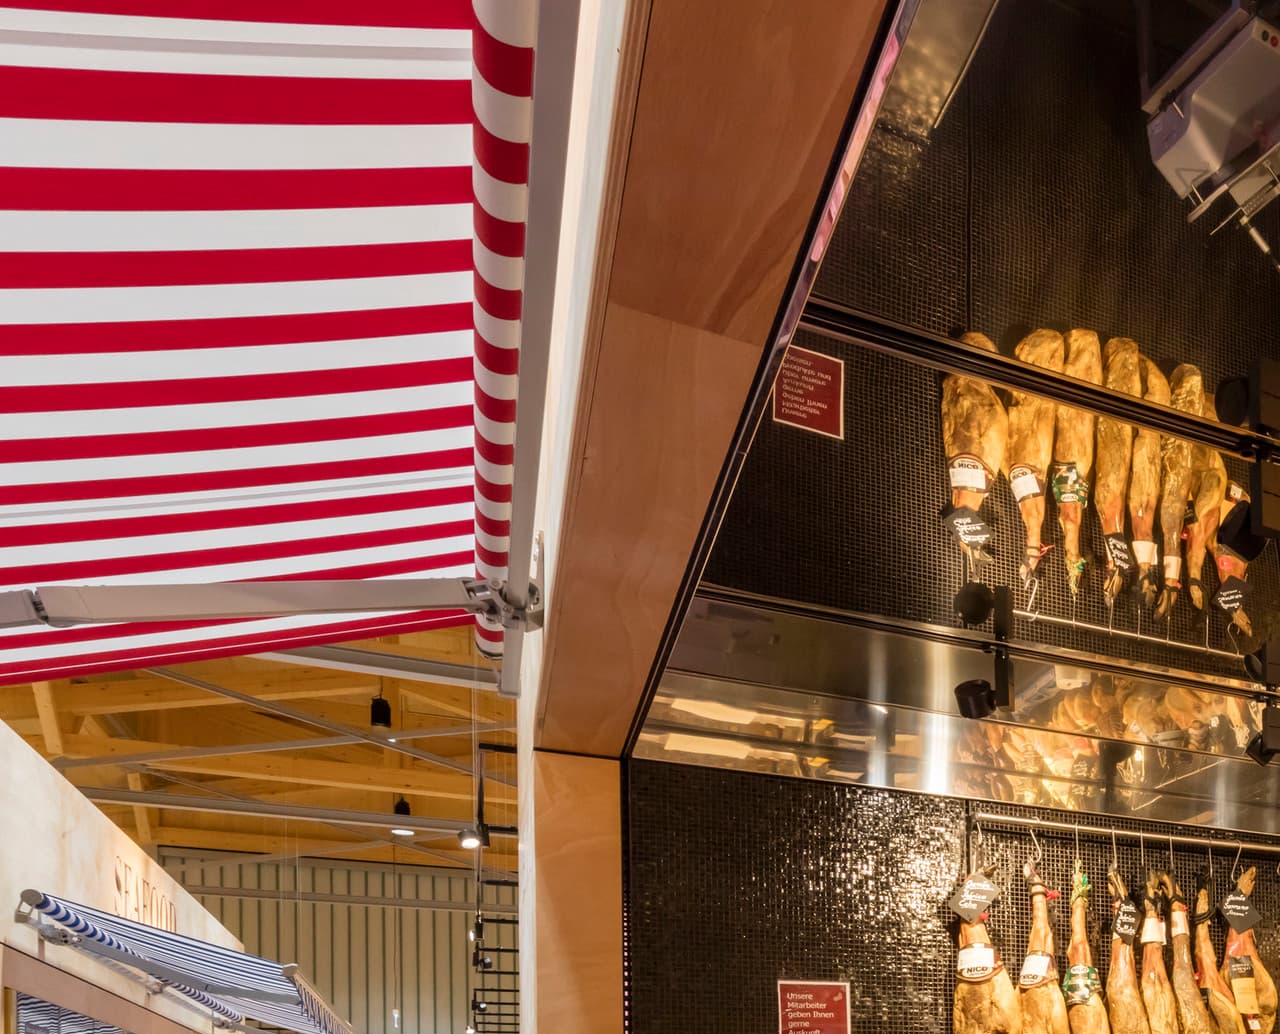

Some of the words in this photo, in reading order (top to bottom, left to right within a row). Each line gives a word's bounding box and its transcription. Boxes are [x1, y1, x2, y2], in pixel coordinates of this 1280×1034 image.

[114, 855, 177, 934] SEAFOOD
[787, 992, 813, 1000] Unsere
[787, 1001, 827, 1009] Mitarbeiter
[788, 1011, 811, 1019] geben
